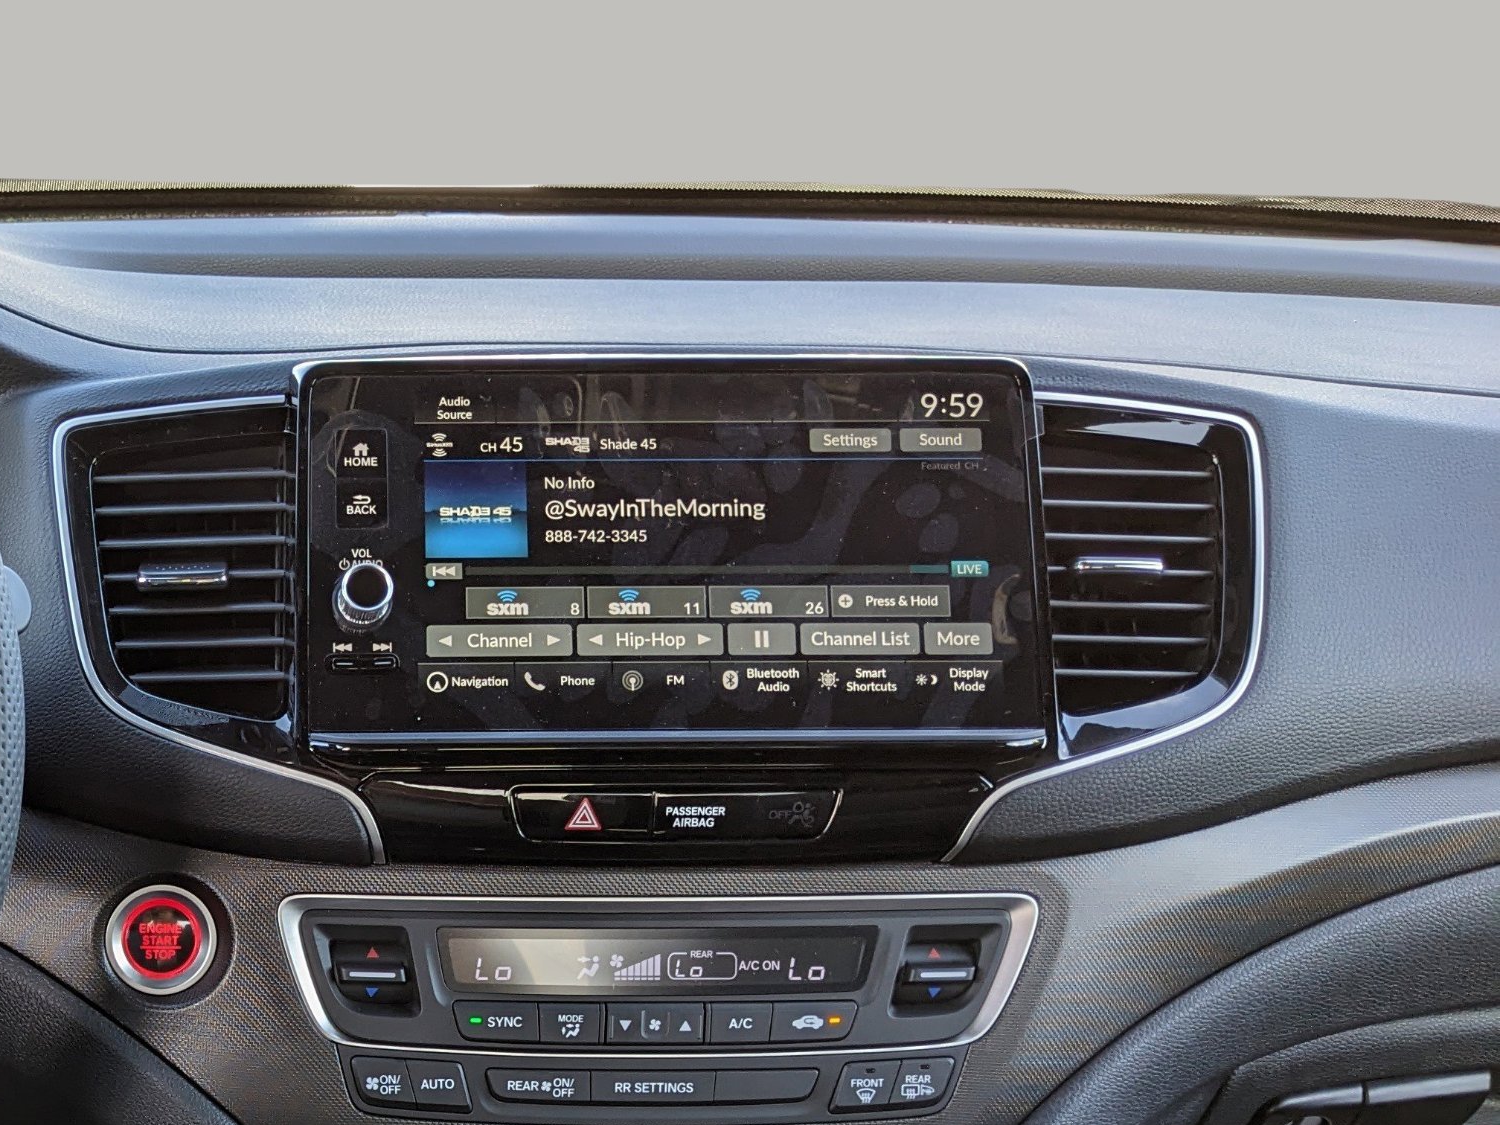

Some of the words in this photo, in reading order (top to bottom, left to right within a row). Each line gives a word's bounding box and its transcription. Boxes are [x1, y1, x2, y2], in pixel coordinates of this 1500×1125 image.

[439, 396, 471, 408] Audio
[920, 393, 984, 418] 9:59
[437, 409, 473, 421] Source
[480, 442, 497, 453] CH
[500, 437, 523, 452] 45
[600, 438, 638, 450] Shade
[640, 438, 657, 450] 45
[823, 433, 878, 450] Settings
[919, 433, 963, 446] Sound
[573, 445, 590, 453] 45
[344, 456, 379, 467] HOME
[544, 476, 564, 490] No
[568, 476, 595, 490] Info
[346, 504, 377, 515] BACK
[545, 498, 766, 521] @SwayInTheMorning
[545, 530, 648, 544] 888-742-3345
[351, 548, 372, 558] VOL
[956, 564, 982, 575] LIVE
[865, 596, 896, 608] Press
[899, 596, 908, 607] &
[911, 595, 939, 607] Hold
[487, 602, 529, 616] sxm
[570, 603, 580, 615] 8
[608, 601, 651, 615] sxm
[683, 603, 700, 615] 11
[730, 601, 773, 615] sxm
[805, 602, 824, 615] 26
[467, 633, 533, 649] Channel
[616, 632, 686, 651] Hip-Hop
[811, 632, 877, 647] Channel
[881, 632, 911, 647] List
[937, 632, 980, 646] More
[746, 668, 800, 679] Bluetooth
[855, 668, 887, 679] Smart
[949, 668, 989, 681] Display
[451, 675, 509, 688] Navigation
[560, 675, 595, 686] Phone
[666, 675, 685, 686] FM
[757, 681, 790, 692] Audio
[846, 681, 897, 692] Shortcuts
[953, 681, 986, 692] Mode
[665, 806, 726, 817] PASSENGER
[672, 817, 715, 828] AIRBAG
[138, 923, 183, 934] ENGINE
[142, 935, 180, 946] START
[145, 949, 176, 960] STOP
[690, 950, 714, 958] REAR
[475, 957, 512, 982] Lo
[739, 961, 760, 972] A/C
[762, 960, 781, 971] ON
[788, 957, 826, 982] Lo
[487, 1016, 523, 1028] SYNC
[558, 1014, 584, 1023] MODE
[728, 1017, 753, 1030] A/C
[379, 1074, 401, 1086] ON/
[420, 1078, 455, 1090] AUTO
[553, 1077, 575, 1088] ON/
[851, 1078, 884, 1088] FRONT
[905, 1074, 931, 1084] REAR
[379, 1085, 402, 1096] OFF
[507, 1080, 539, 1091] REAR
[614, 1082, 631, 1093] RR
[634, 1082, 695, 1094] SETTINGS
[553, 1087, 575, 1098] OFF
